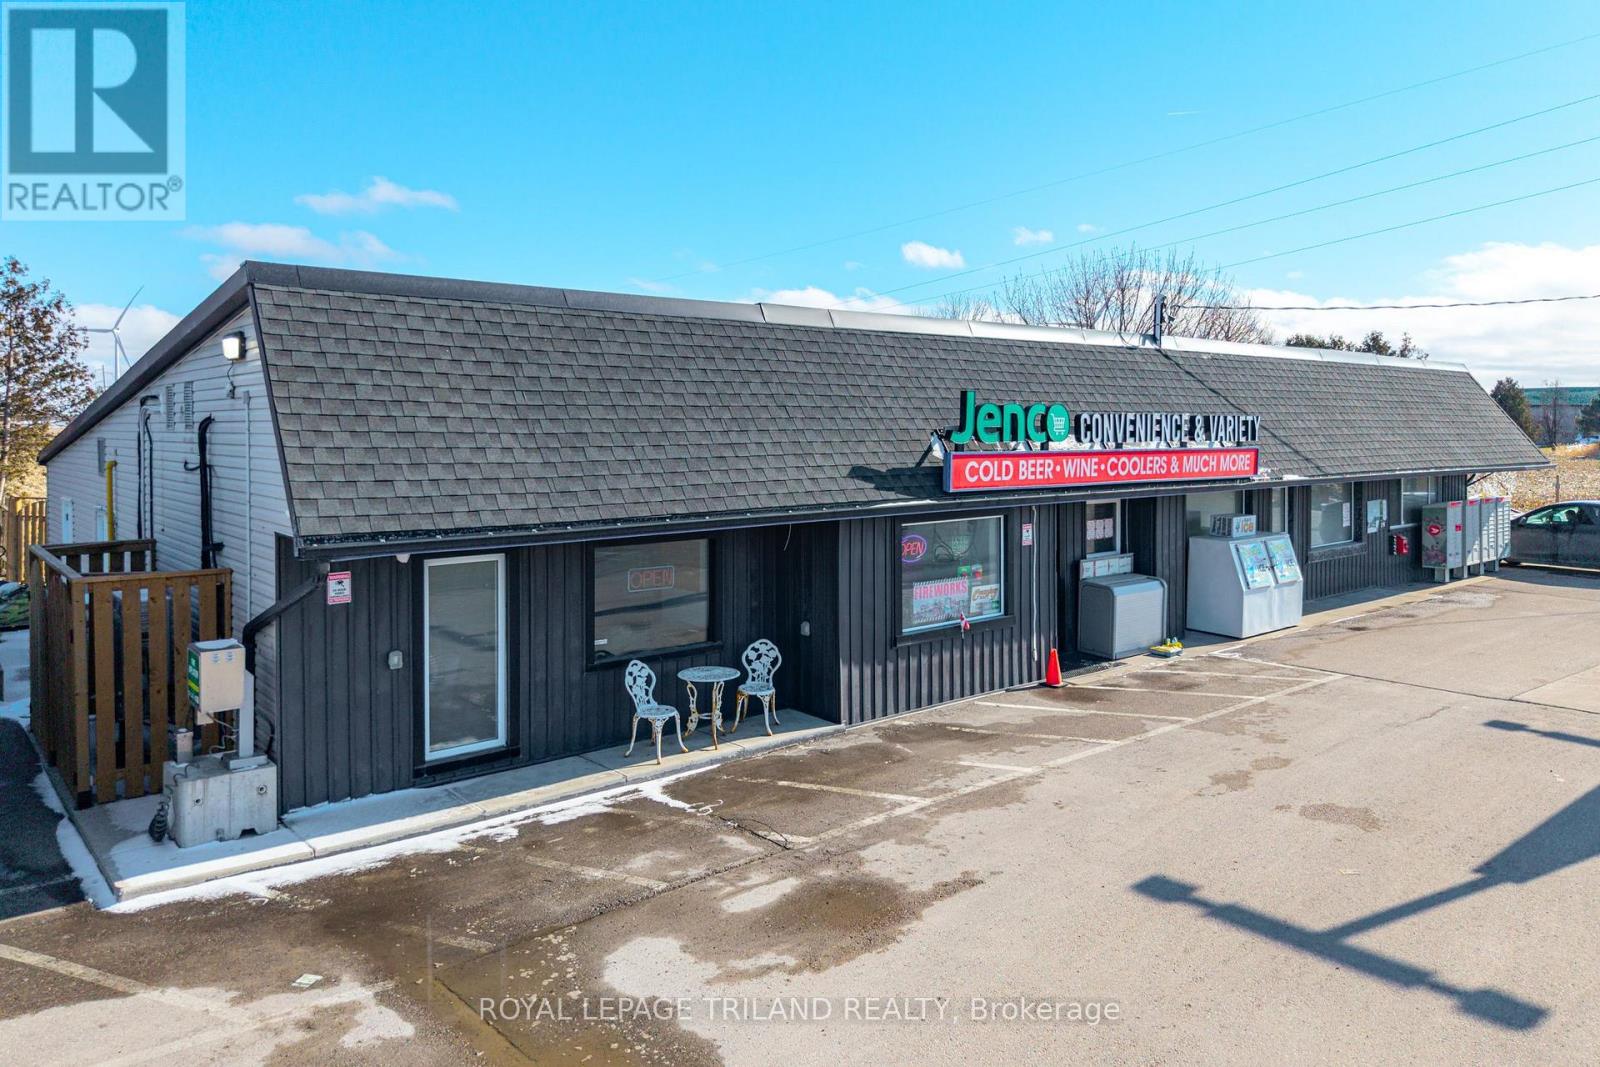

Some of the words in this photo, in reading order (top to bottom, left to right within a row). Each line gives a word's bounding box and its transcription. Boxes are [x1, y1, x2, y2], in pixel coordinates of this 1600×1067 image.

[951, 390, 1070, 444] Jenco
[1079, 412, 1189, 443] CONVENIENCE
[1194, 413, 1206, 442] &
[1209, 415, 1261, 442] VARIETY
[965, 459, 1013, 482] COLD
[1018, 458, 1054, 480] BEER
[1063, 456, 1099, 478] WINE
[1107, 454, 1167, 477] COOLERS
[1170, 456, 1179, 474] &
[1182, 454, 1217, 474] MUCH
[1219, 453, 1251, 472] MORE
[631, 567, 673, 589] OPEN
[914, 580, 968, 600] FIREWORKS
